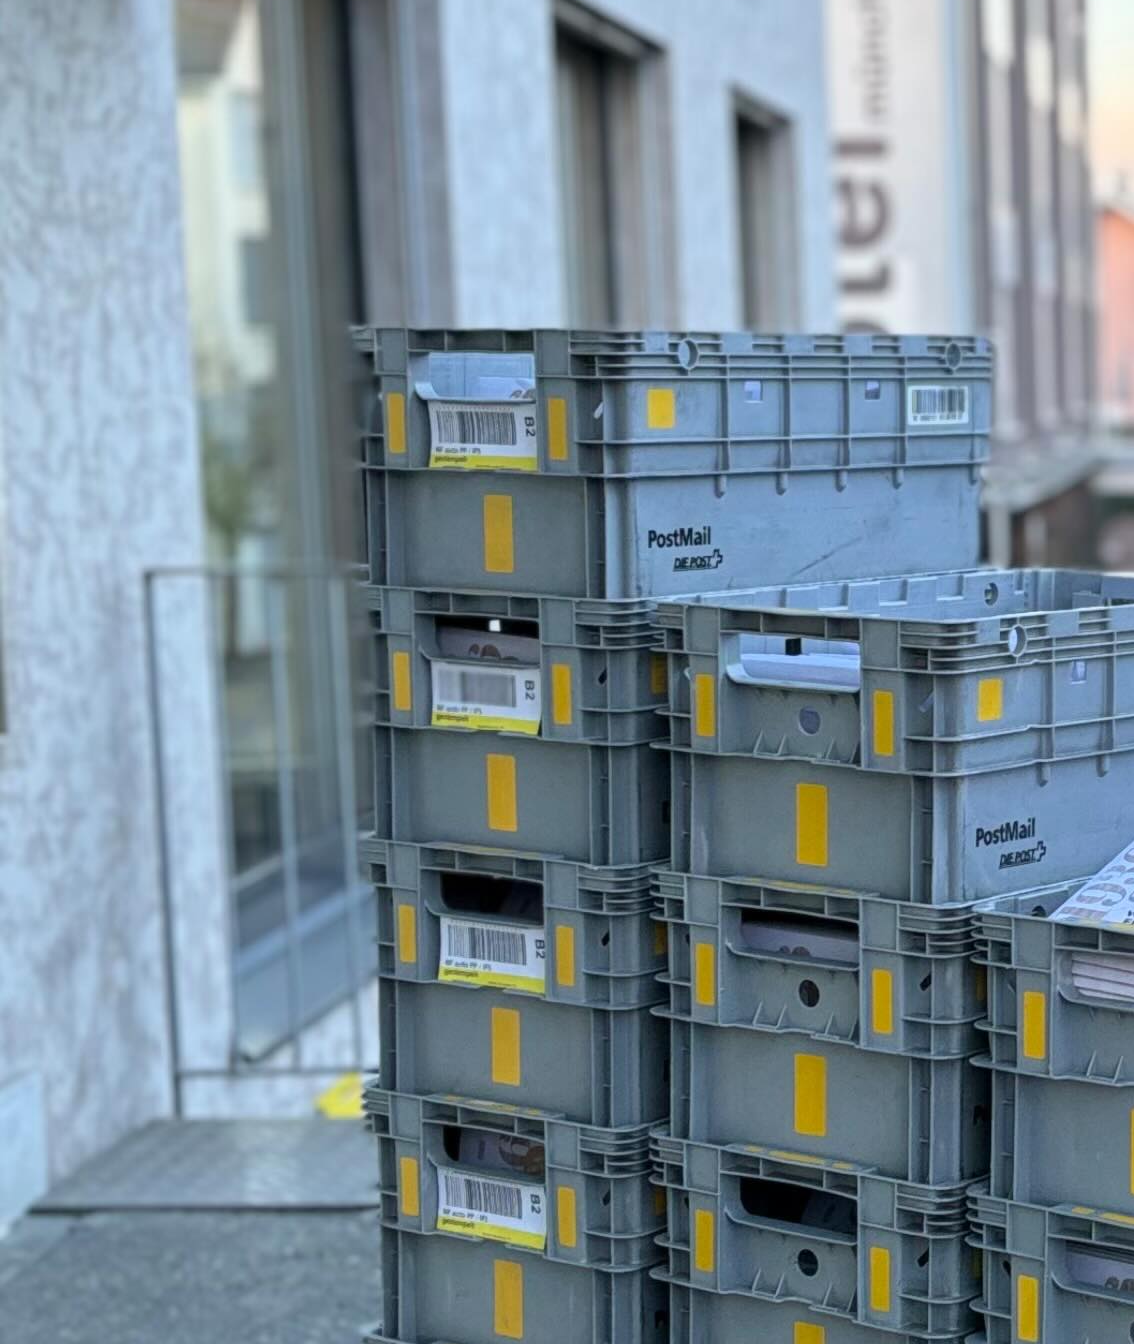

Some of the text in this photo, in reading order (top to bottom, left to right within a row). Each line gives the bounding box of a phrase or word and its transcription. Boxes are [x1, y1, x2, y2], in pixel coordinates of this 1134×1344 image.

[524, 416, 536, 437] B2
[647, 525, 711, 548] PostMail
[525, 679, 536, 701] B2
[975, 817, 1036, 848] PostMail
[534, 939, 546, 959] B2
[530, 1194, 542, 1215] B2
